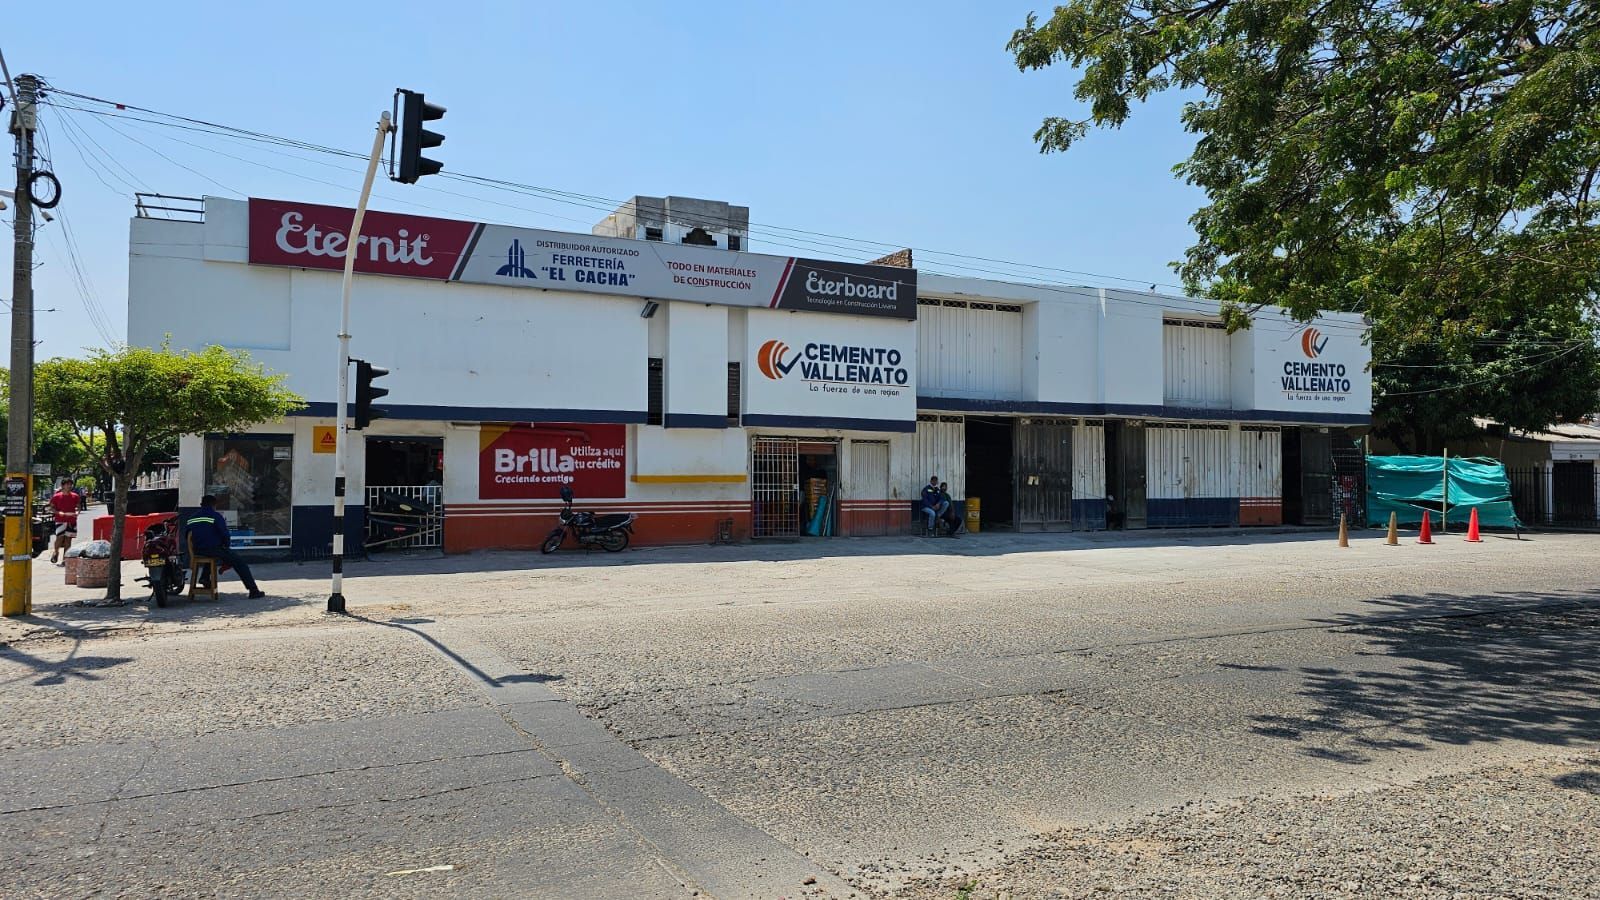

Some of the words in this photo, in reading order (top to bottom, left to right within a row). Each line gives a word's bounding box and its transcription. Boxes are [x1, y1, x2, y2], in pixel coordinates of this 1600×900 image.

[536, 240, 590, 252] DISTRIBUIDOR
[591, 245, 640, 257] AUTORIZADO
[552, 253, 625, 270] FERRETERÍA
[667, 261, 692, 271] TODO
[693, 264, 705, 273] EN
[706, 265, 757, 278] MATERIALES
[673, 275, 686, 284] DE
[687, 276, 751, 290] CONSTRUCCIÓN
[805, 271, 897, 300] Eterboard
[804, 343, 901, 366] CEMENTO
[800, 361, 908, 385] VALLENATO
[1283, 361, 1346, 377] CEMENTO
[809, 382, 819, 392] La
[822, 383, 848, 393] fuerza
[852, 385, 861, 394] de
[1281, 376, 1351, 392] VALLENATO
[570, 446, 601, 457] Utiliza
[603, 445, 624, 458] aquí
[494, 448, 575, 473] Brilla
[575, 460, 585, 469] tu
[586, 457, 621, 469] crédito
[494, 474, 541, 484] Creciendo
[541, 474, 574, 484] contigo
